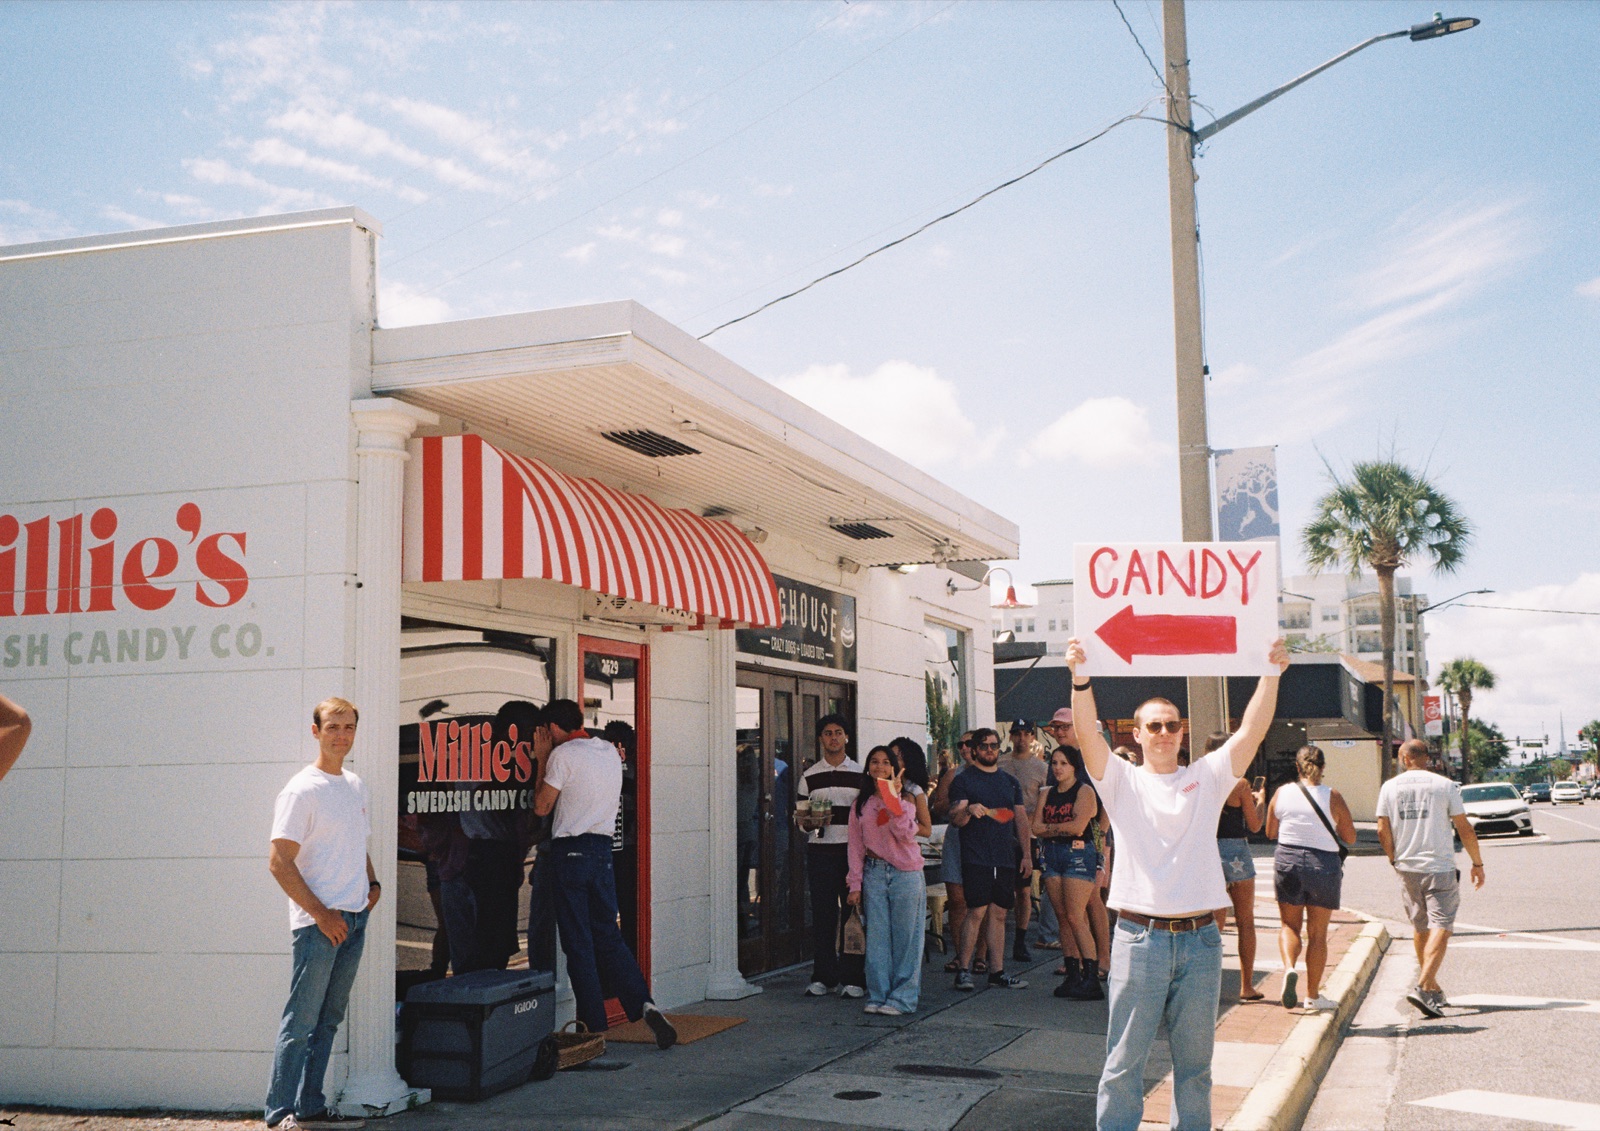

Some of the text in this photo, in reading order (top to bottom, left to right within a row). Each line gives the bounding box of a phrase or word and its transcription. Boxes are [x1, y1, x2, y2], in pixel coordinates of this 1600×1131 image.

[0, 502, 249, 617] illie's
[1088, 546, 1262, 605] CANDY
[3, 622, 275, 668] SH CANDY CO.
[417, 720, 532, 783] Millie's
[407, 790, 471, 814] SWEDISH
[473, 789, 518, 812] CANDY
